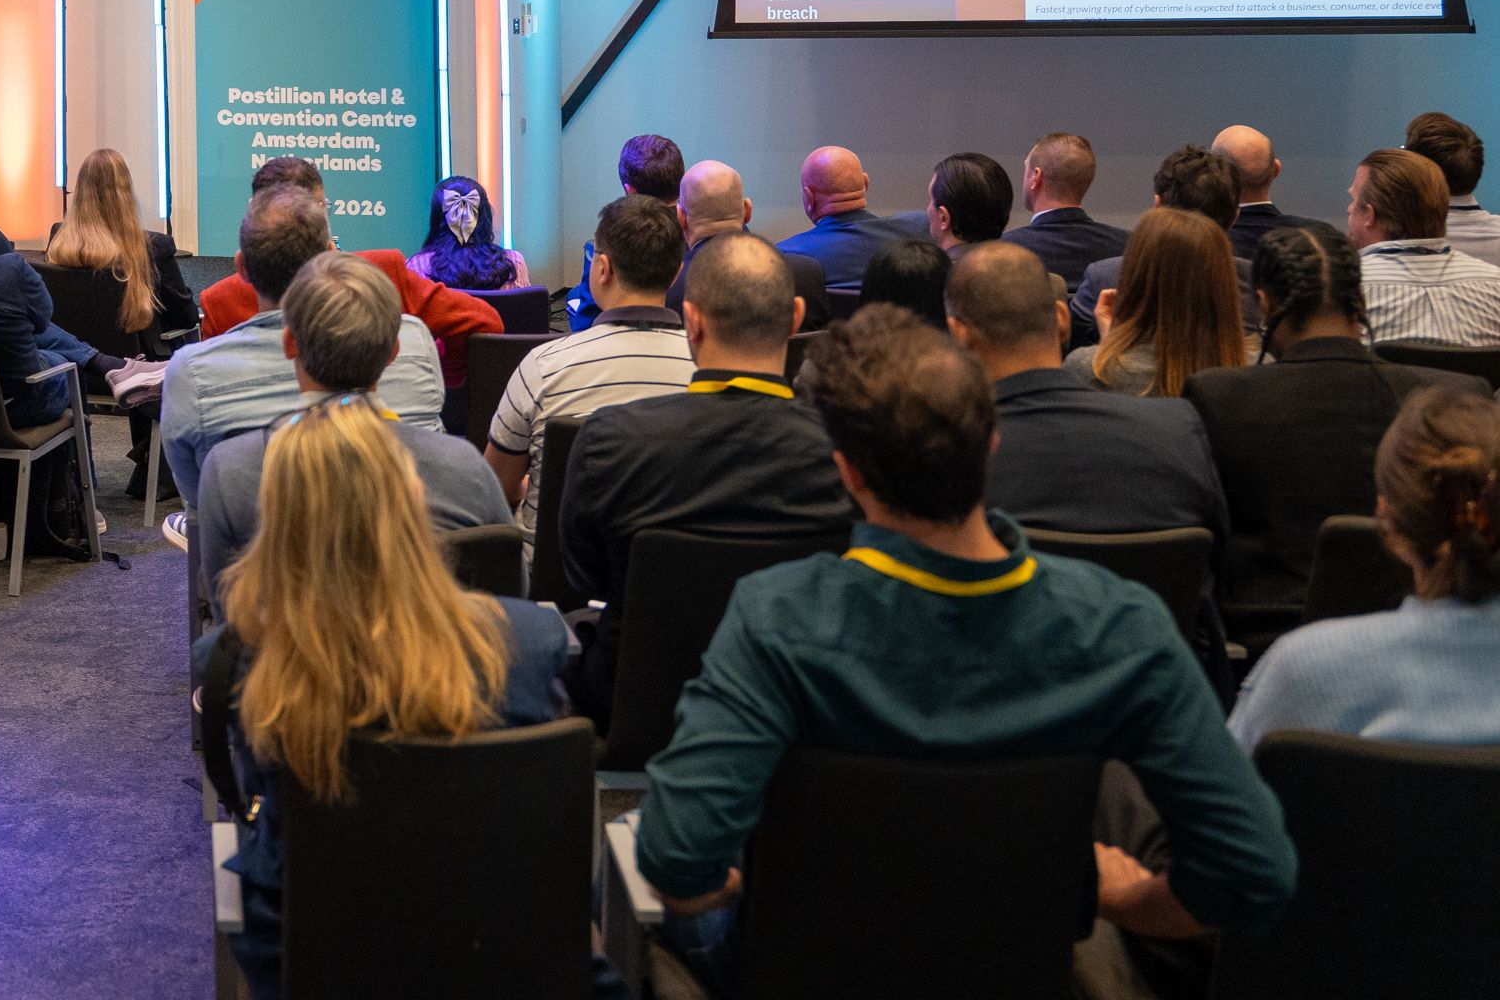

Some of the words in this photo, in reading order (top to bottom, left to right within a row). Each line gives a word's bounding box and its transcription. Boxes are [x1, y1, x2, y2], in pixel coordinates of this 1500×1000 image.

[767, 5, 817, 20] breach
[228, 86, 325, 104] Postillion
[330, 88, 387, 105] Hotel
[391, 88, 405, 105] &
[217, 108, 338, 127] Convention
[341, 110, 416, 127] Centre
[251, 131, 380, 153] Amsterdam,
[251, 153, 382, 172] Nrlands
[334, 199, 386, 217] 2026
